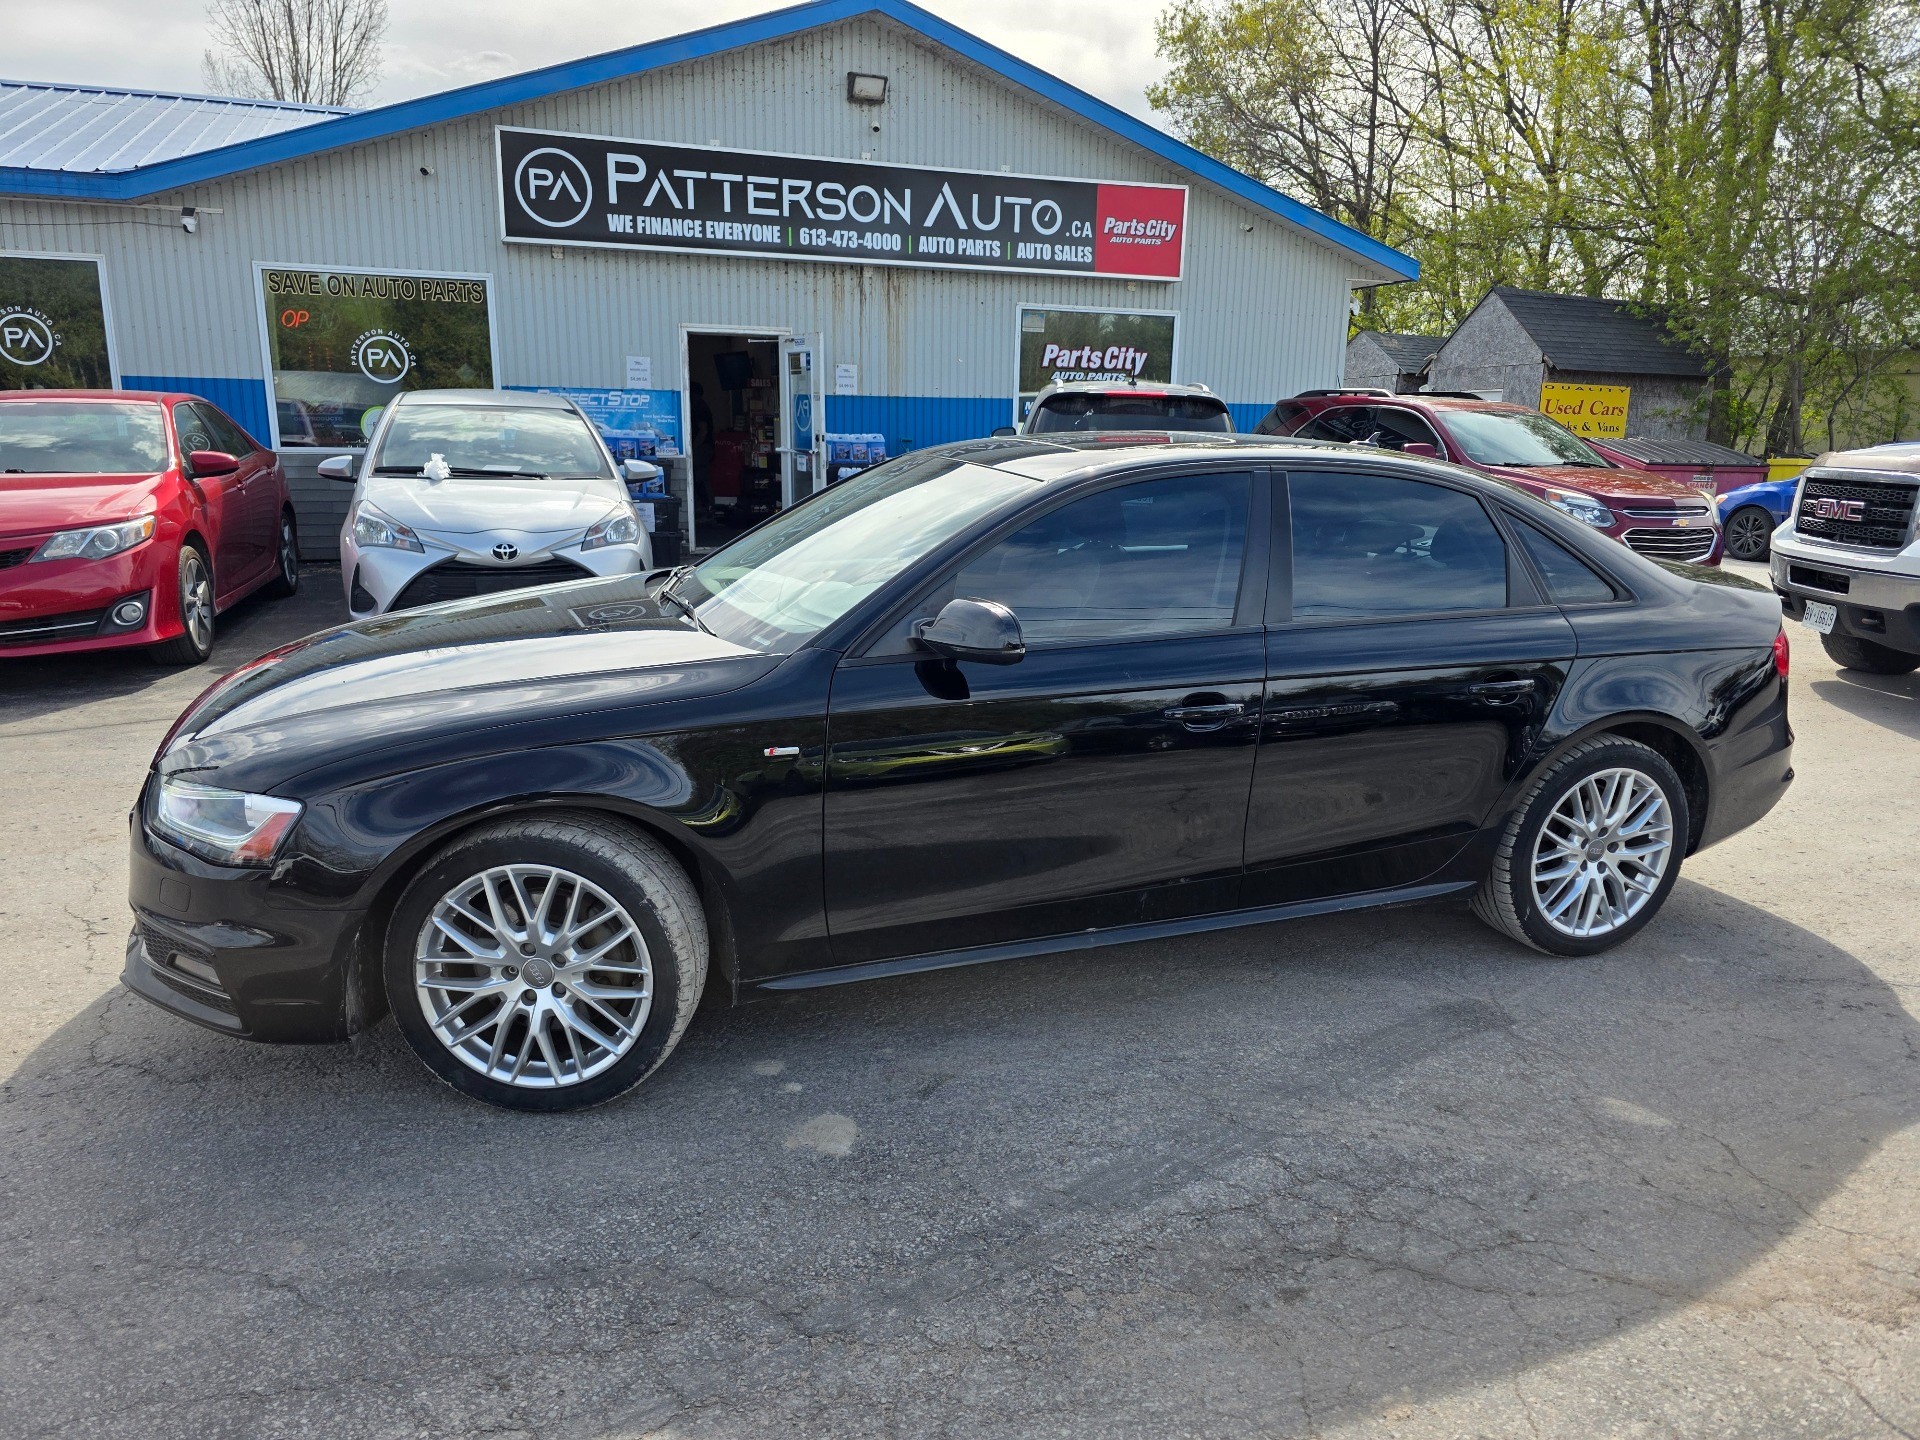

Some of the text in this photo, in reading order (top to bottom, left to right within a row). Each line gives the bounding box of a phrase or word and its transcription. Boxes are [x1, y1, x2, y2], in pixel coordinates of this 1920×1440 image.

[528, 167, 582, 203] PA
[607, 152, 911, 227] PATTERSON
[923, 181, 1063, 236] AUTO
[607, 213, 782, 243] WE FINANCE EVERYONE
[799, 227, 902, 251] 613-473-4000
[918, 236, 1001, 258] AUTO PARTS
[1109, 236, 1162, 246] AUTO PARTS
[1016, 242, 1093, 263] AUTO SALES
[268, 272, 484, 303] SAVE ON AUTO PARTS
[27, 307, 53, 326] AUTO
[3, 327, 46, 349] PA
[350, 328, 384, 366] PATTERSON
[387, 330, 410, 348] AUTO
[366, 348, 402, 369] PA
[1051, 371, 1126, 383] AUTO PARTS
[538, 389, 650, 406] RFECTSTOP
[1544, 384, 1628, 394] QUALITY
[1544, 398, 1625, 417] Used Cars
[1582, 421, 1592, 432] &
[1597, 422, 1620, 432] Vans
[1815, 498, 1865, 522] GMC
